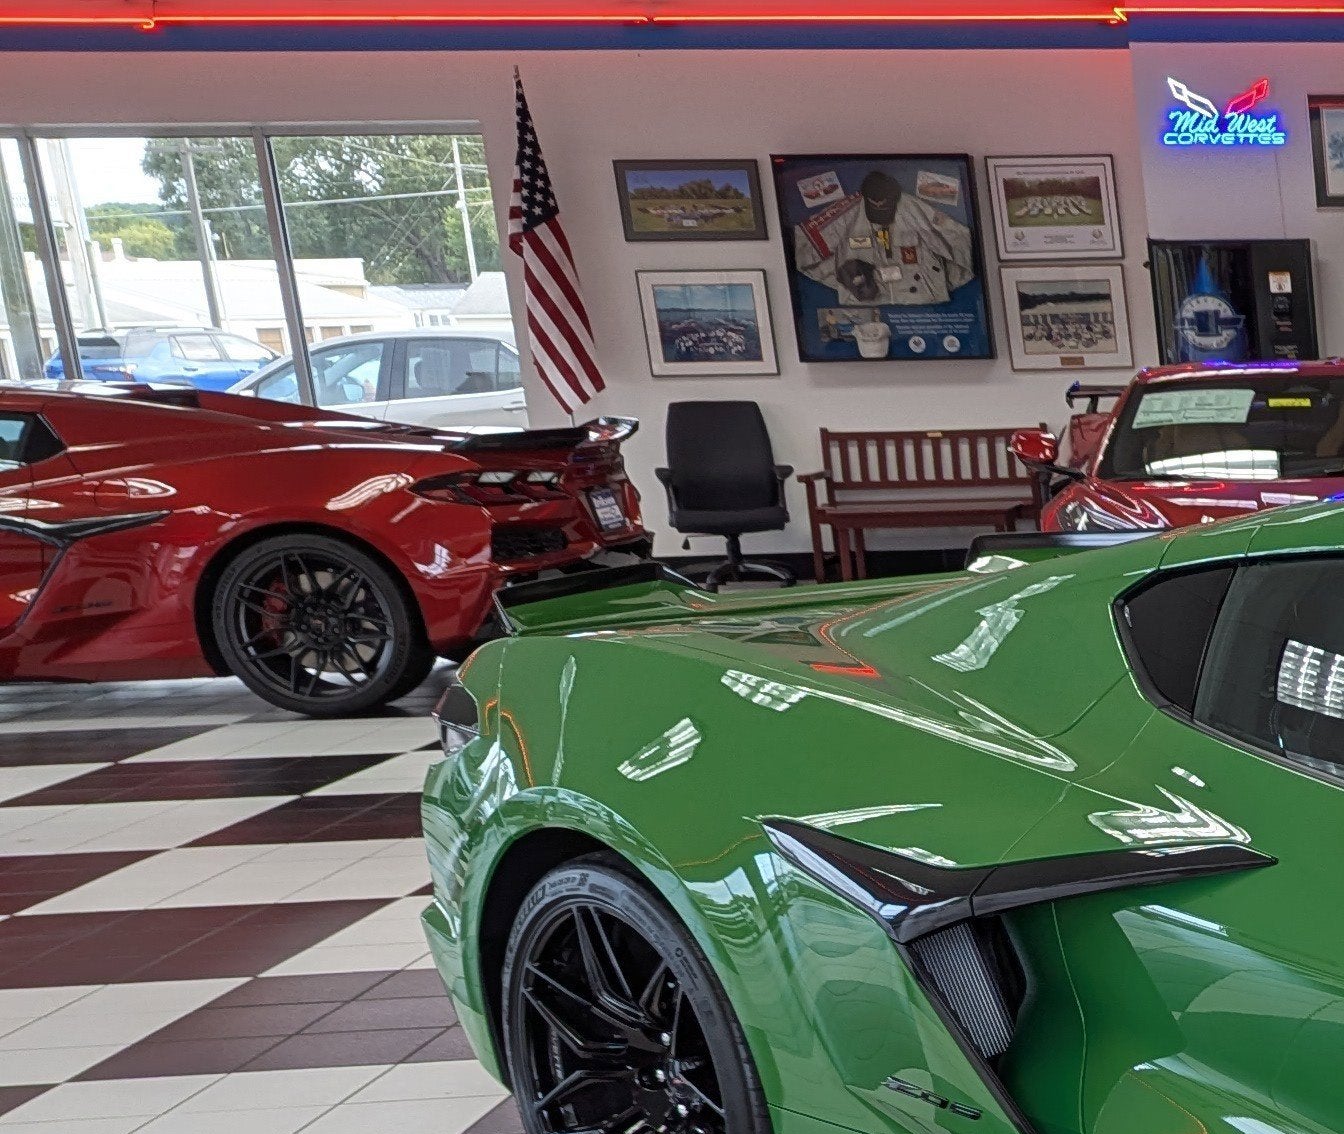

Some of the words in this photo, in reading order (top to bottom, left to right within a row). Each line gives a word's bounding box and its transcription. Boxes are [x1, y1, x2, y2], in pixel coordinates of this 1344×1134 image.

[1169, 111, 1219, 132] Mid
[1225, 111, 1276, 132] West
[1163, 132, 1286, 145] CORVETTES
